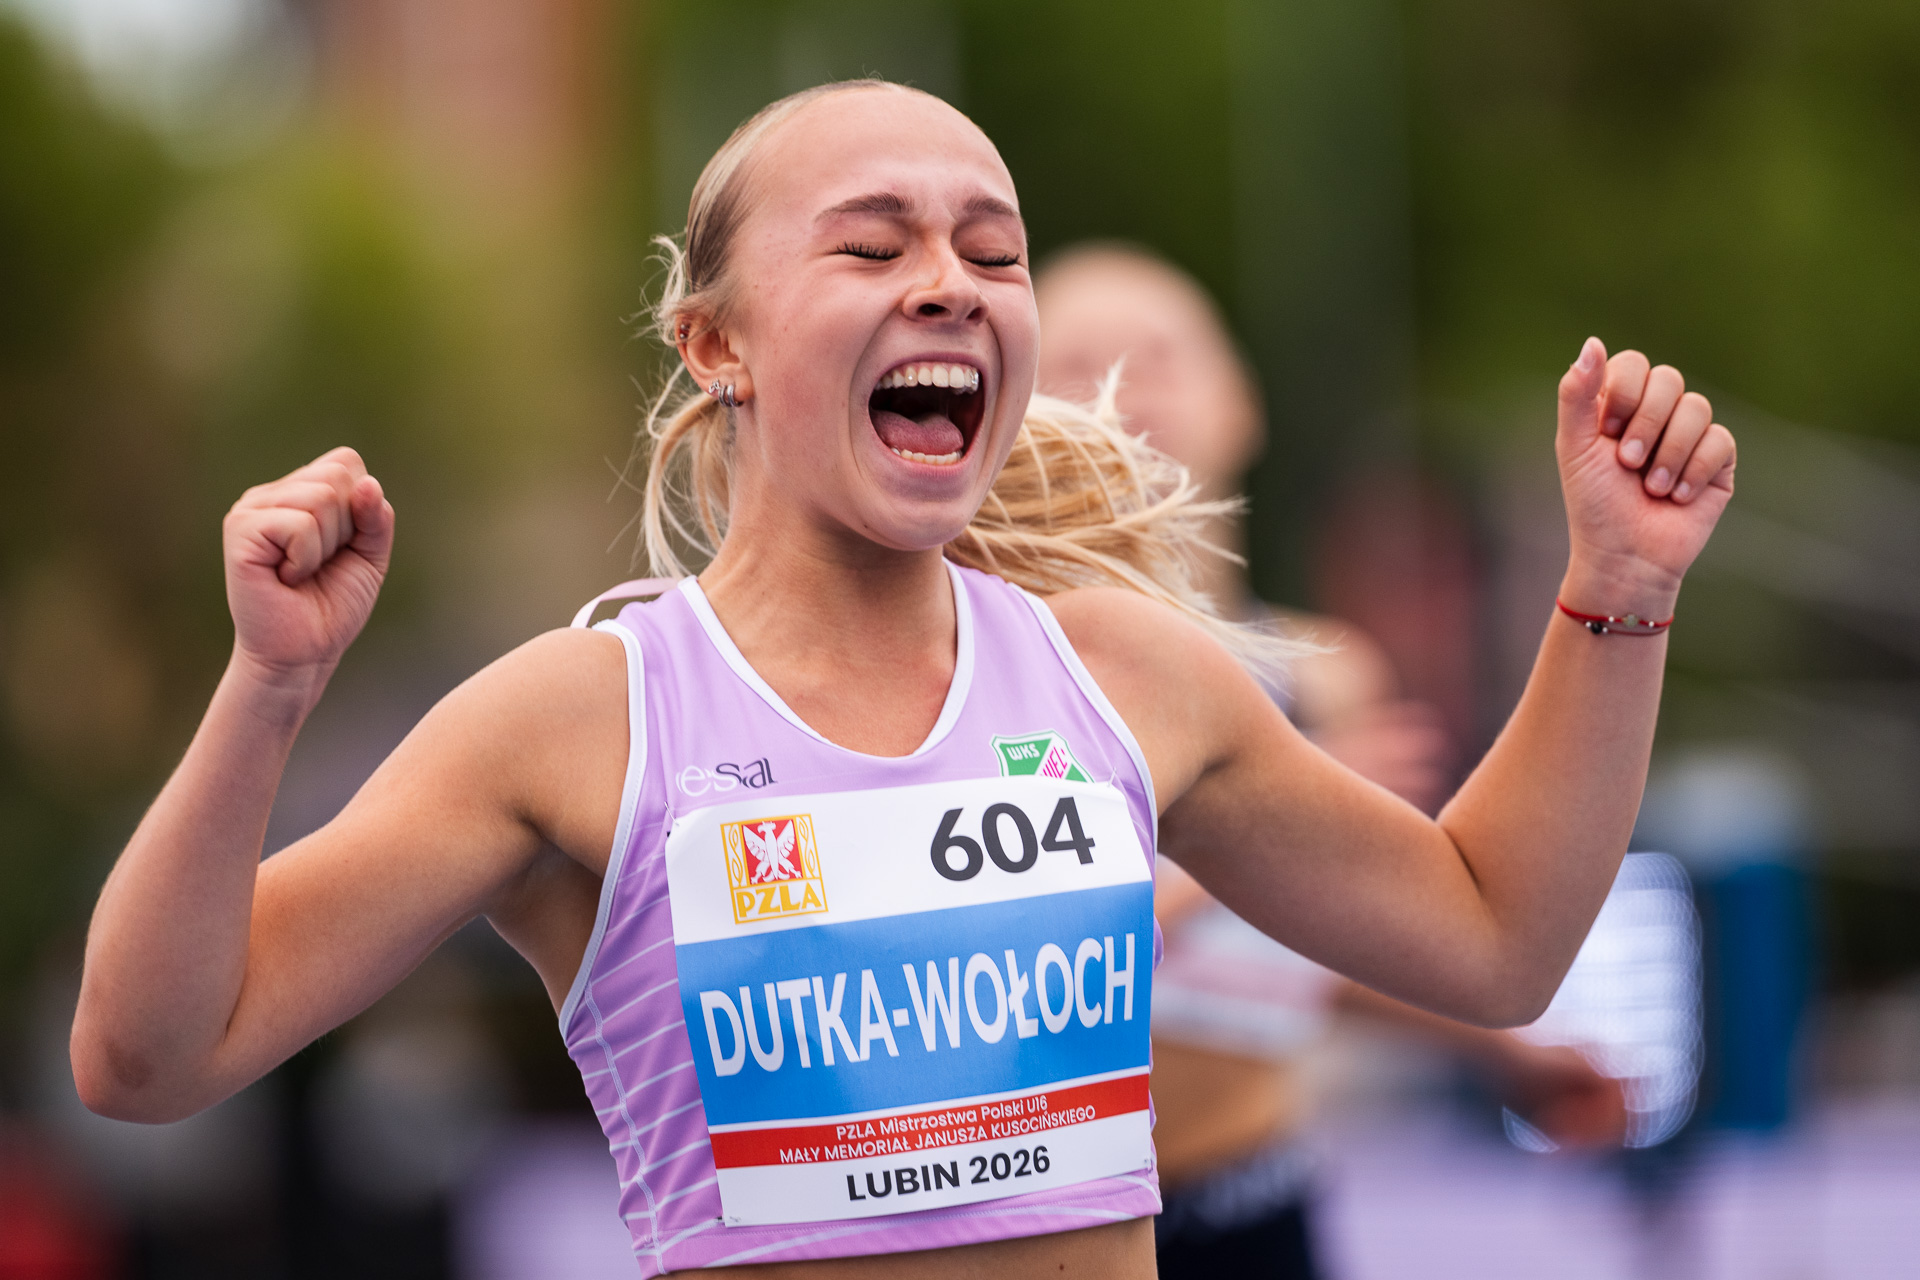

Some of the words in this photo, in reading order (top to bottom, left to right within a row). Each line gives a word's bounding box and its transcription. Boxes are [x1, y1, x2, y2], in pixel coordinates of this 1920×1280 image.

[1006, 743, 1040, 761] WKS
[930, 796, 1096, 882] 604
[735, 881, 823, 918] PZLA
[699, 932, 1136, 1077] DUTKA-WOŁOCH
[779, 1146, 820, 1164] MAŁY
[824, 1136, 911, 1161] MEMORIAŁ
[915, 1125, 988, 1150] JANUSZA
[991, 1105, 1096, 1139] KUSOCIŃSKIEGO
[836, 1122, 877, 1141] PZLA
[879, 1108, 977, 1136] Mistrzostwa
[981, 1100, 1024, 1121] Polski
[1027, 1095, 1048, 1113] U16
[846, 1160, 960, 1202] LUBIN
[969, 1145, 1050, 1185] 2026
